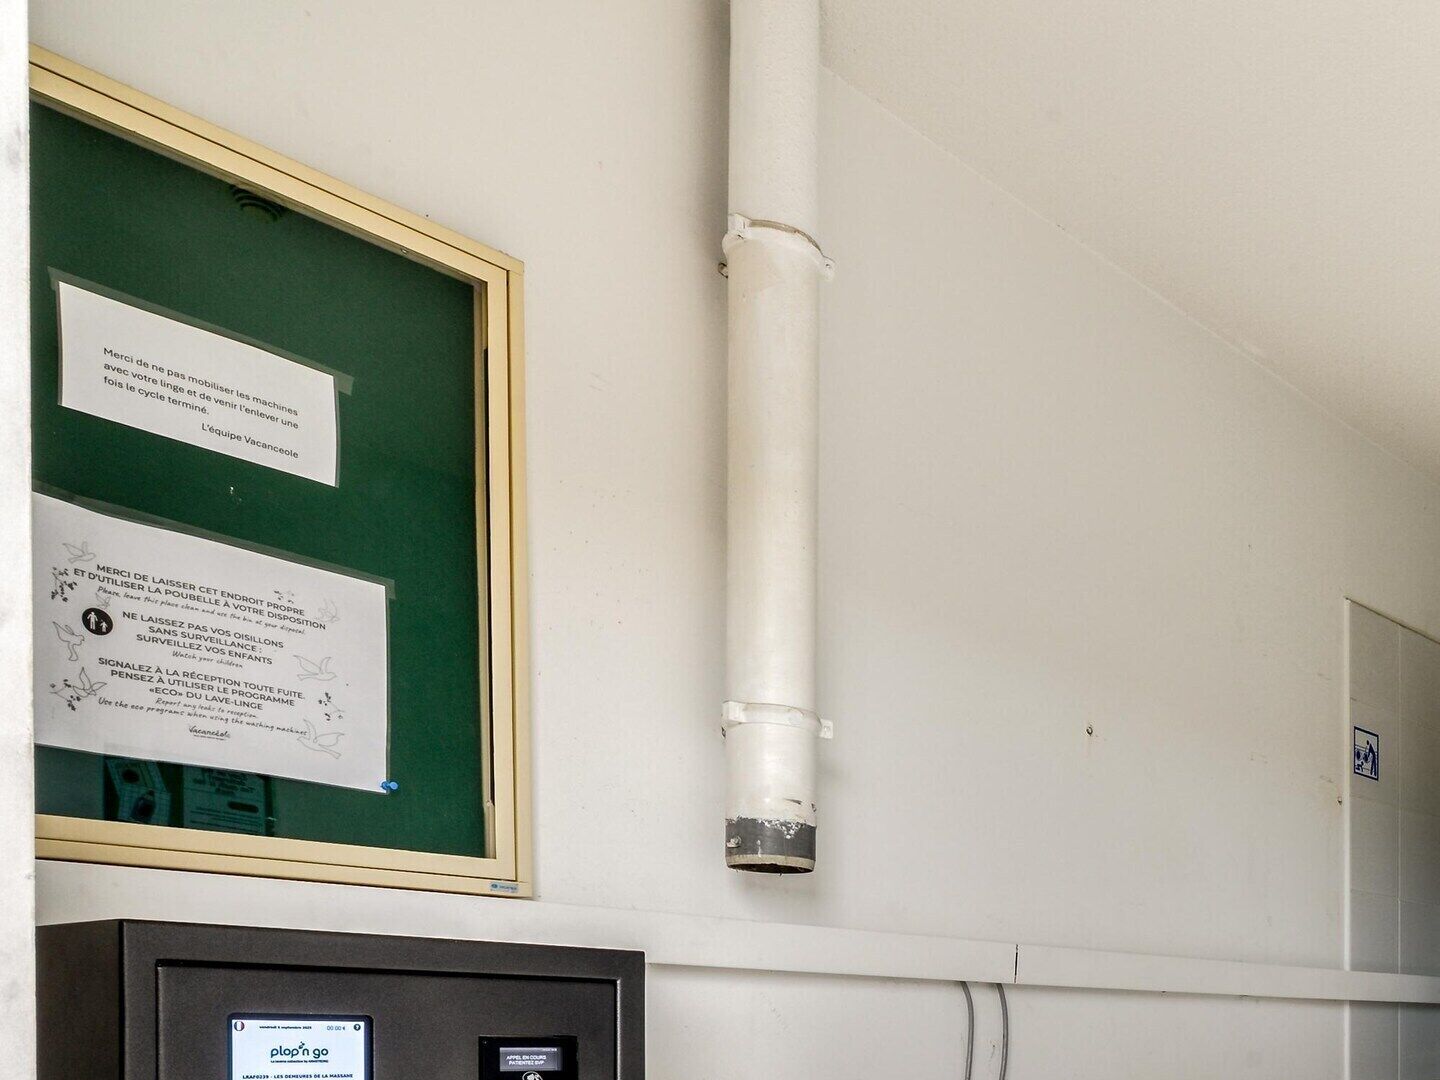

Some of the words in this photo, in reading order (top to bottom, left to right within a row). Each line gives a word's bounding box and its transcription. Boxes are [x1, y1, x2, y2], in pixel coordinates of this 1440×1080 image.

[104, 347, 133, 363] Merci
[136, 359, 148, 368] de
[152, 364, 164, 373] ne
[167, 369, 186, 380] pas
[188, 376, 234, 394] mobiliser
[236, 390, 250, 400] les
[252, 396, 298, 416] machines
[104, 376, 124, 388] fois
[126, 383, 136, 392] le
[138, 388, 165, 402] cycle
[168, 396, 209, 414] terminé.
[104, 363, 129, 376] avec
[131, 372, 158, 385] votre
[160, 379, 184, 393] linge
[187, 389, 196, 397] et
[200, 393, 212, 402] de
[214, 398, 237, 409] venir
[281, 419, 298, 429] une
[202, 423, 242, 441] L'équipe
[244, 436, 298, 458] Vacanceole
[74, 568, 86, 577] ET
[89, 573, 145, 591] D'UTILISER
[148, 586, 162, 594] LA
[165, 588, 220, 606] POUBELLE
[223, 600, 230, 608] À
[233, 603, 264, 616] VOTRE
[268, 611, 326, 630] DISPOSITION
[97, 564, 130, 578] MERCI
[134, 573, 148, 582] DE
[152, 577, 196, 591] LAISSER
[199, 586, 218, 595] CET
[221, 591, 264, 606] ENDROIT
[267, 602, 305, 616] PROPRE
[122, 611, 137, 620] NE
[141, 615, 185, 628] LAISSEZ
[188, 622, 208, 632] PAS
[211, 627, 231, 637] VOS
[234, 632, 284, 648] OISILLONS
[148, 626, 178, 637] SANS
[180, 632, 257, 652] SURVEILLANCE
[136, 634, 202, 650] SURVEILLEZ
[205, 645, 226, 655] VOS
[228, 650, 273, 665] ENFANTS
[98, 657, 152, 672] SIGNALEZ
[155, 666, 163, 674] À
[166, 669, 180, 677] LA
[182, 671, 240, 687] RÉCEPTION
[244, 682, 274, 693] TOUTE
[277, 689, 305, 699] FUITE.
[111, 670, 154, 683] PENSEZ
[157, 676, 165, 684] À
[168, 679, 214, 691] UTILISER
[232, 689, 295, 706] PROGRAMME
[205, 694, 263, 710] LAVE-LINGE
[313, 1048, 329, 1058] go
